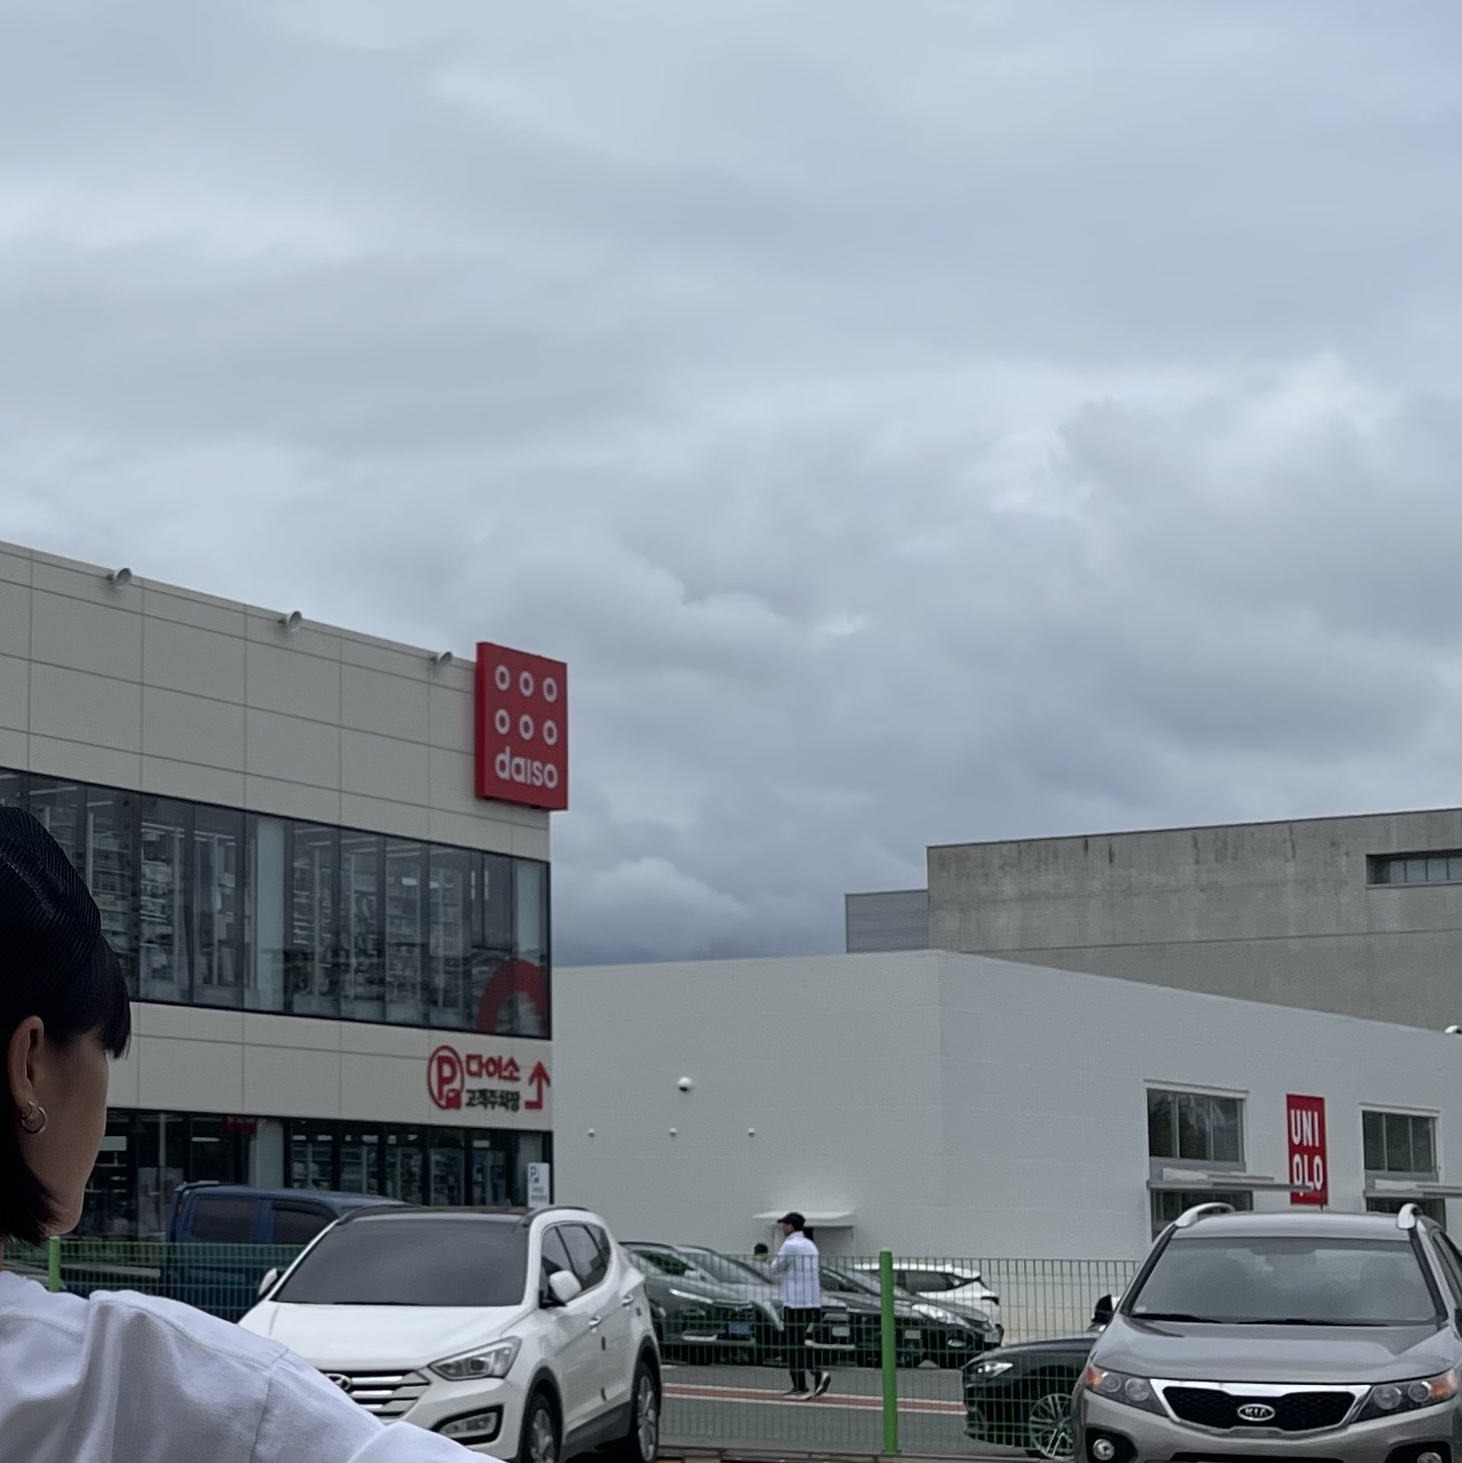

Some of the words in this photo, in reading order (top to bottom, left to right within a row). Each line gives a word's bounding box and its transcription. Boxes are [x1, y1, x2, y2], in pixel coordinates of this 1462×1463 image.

[495, 747, 558, 789] daiso
[437, 1055, 457, 1101] P
[466, 1053, 520, 1081] 다이소
[1291, 1109, 1319, 1147] UNI
[1244, 1407, 1269, 1418] KIA
